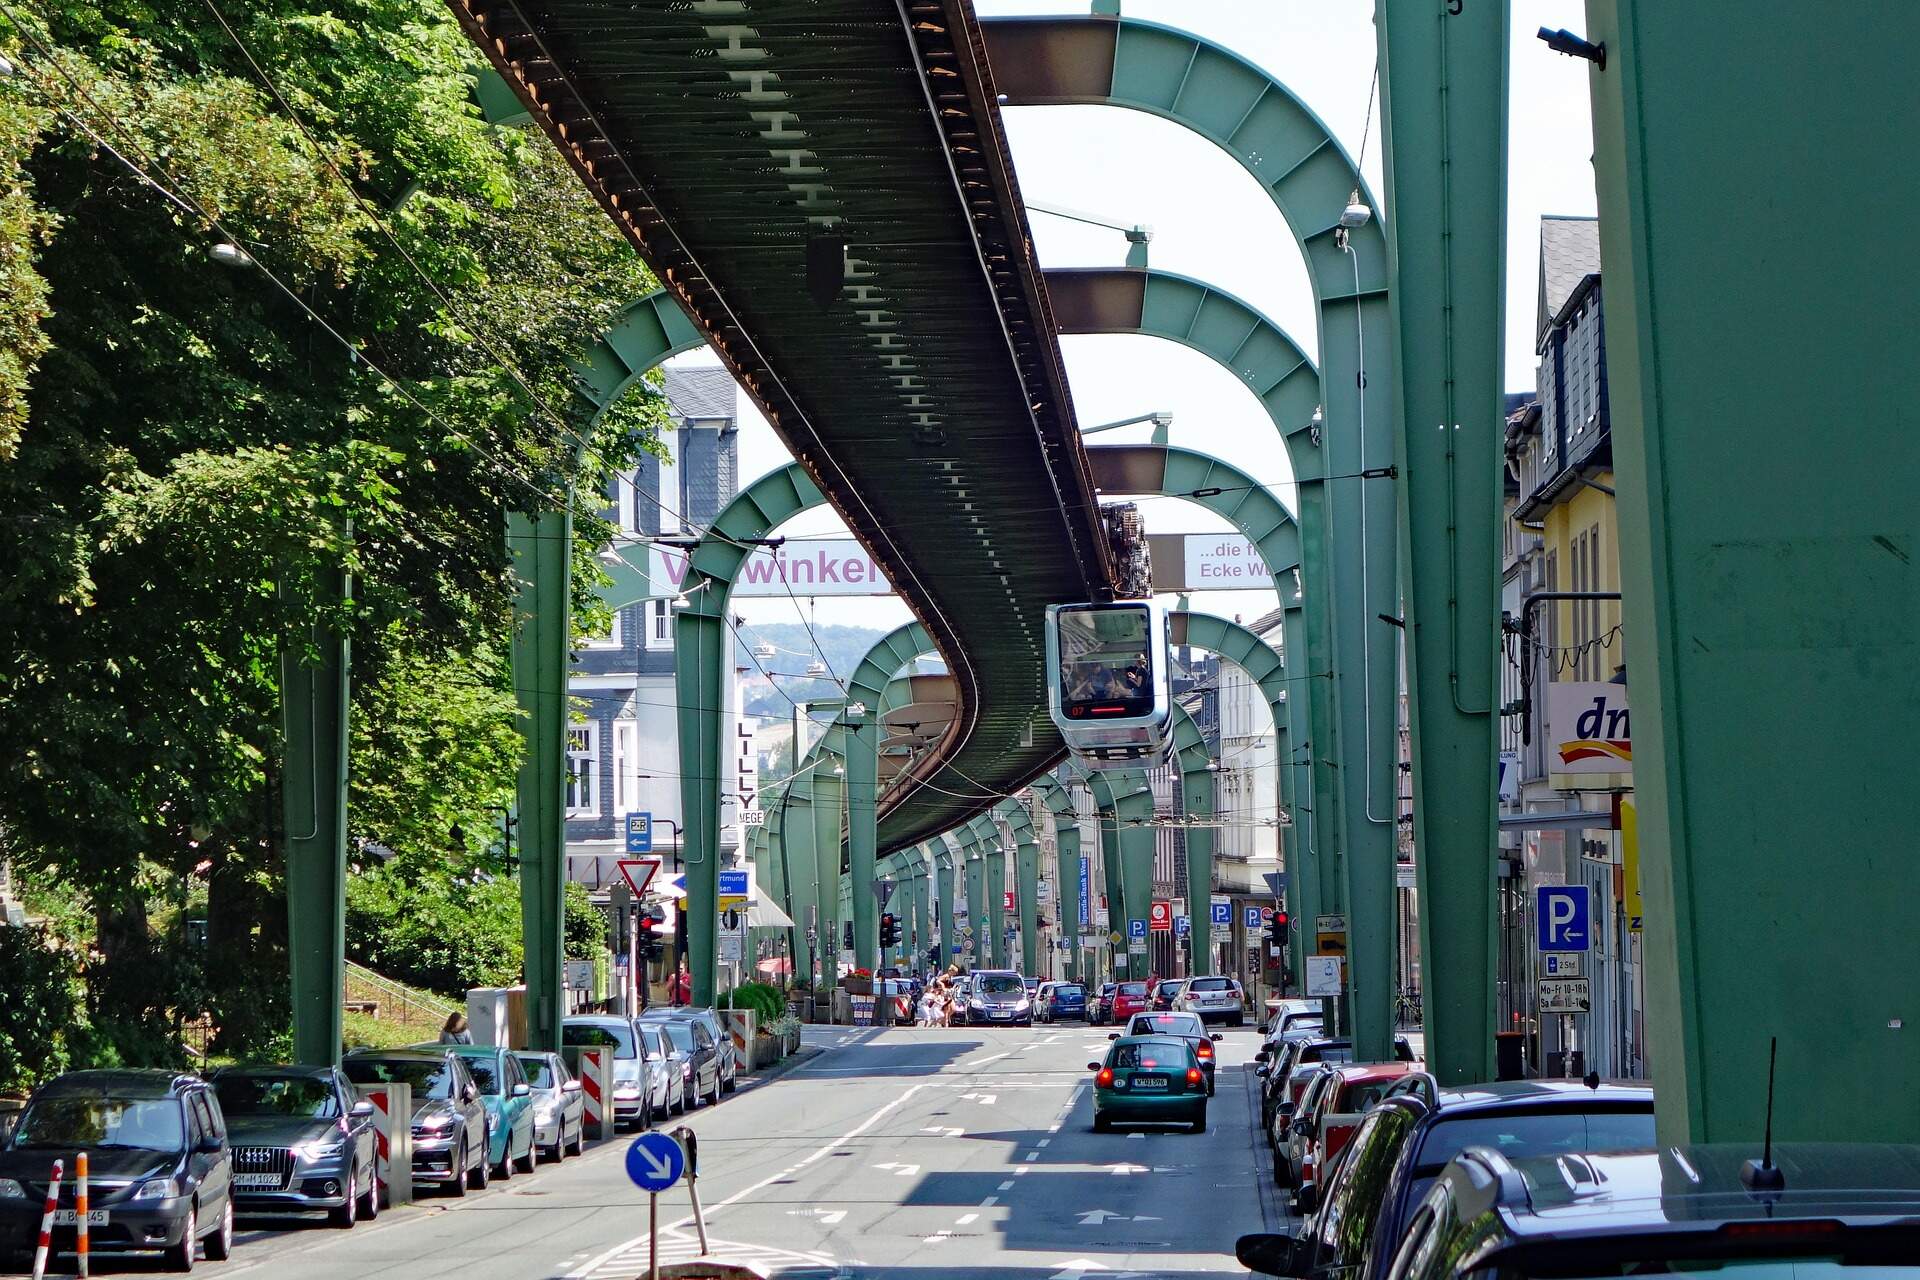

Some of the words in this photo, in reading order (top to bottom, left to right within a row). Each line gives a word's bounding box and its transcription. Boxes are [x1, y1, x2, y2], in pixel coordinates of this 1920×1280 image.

[1201, 563, 1242, 577] Ecke
[738, 722, 756, 810] LILLY
[1216, 906, 1227, 921] P
[1248, 910, 1258, 925] P
[1549, 895, 1576, 943] P
[1132, 921, 1143, 936] P
[1064, 935, 1070, 947] P
[1540, 985, 1562, 994] Mo-Fr
[1540, 999, 1549, 1008] Sa
